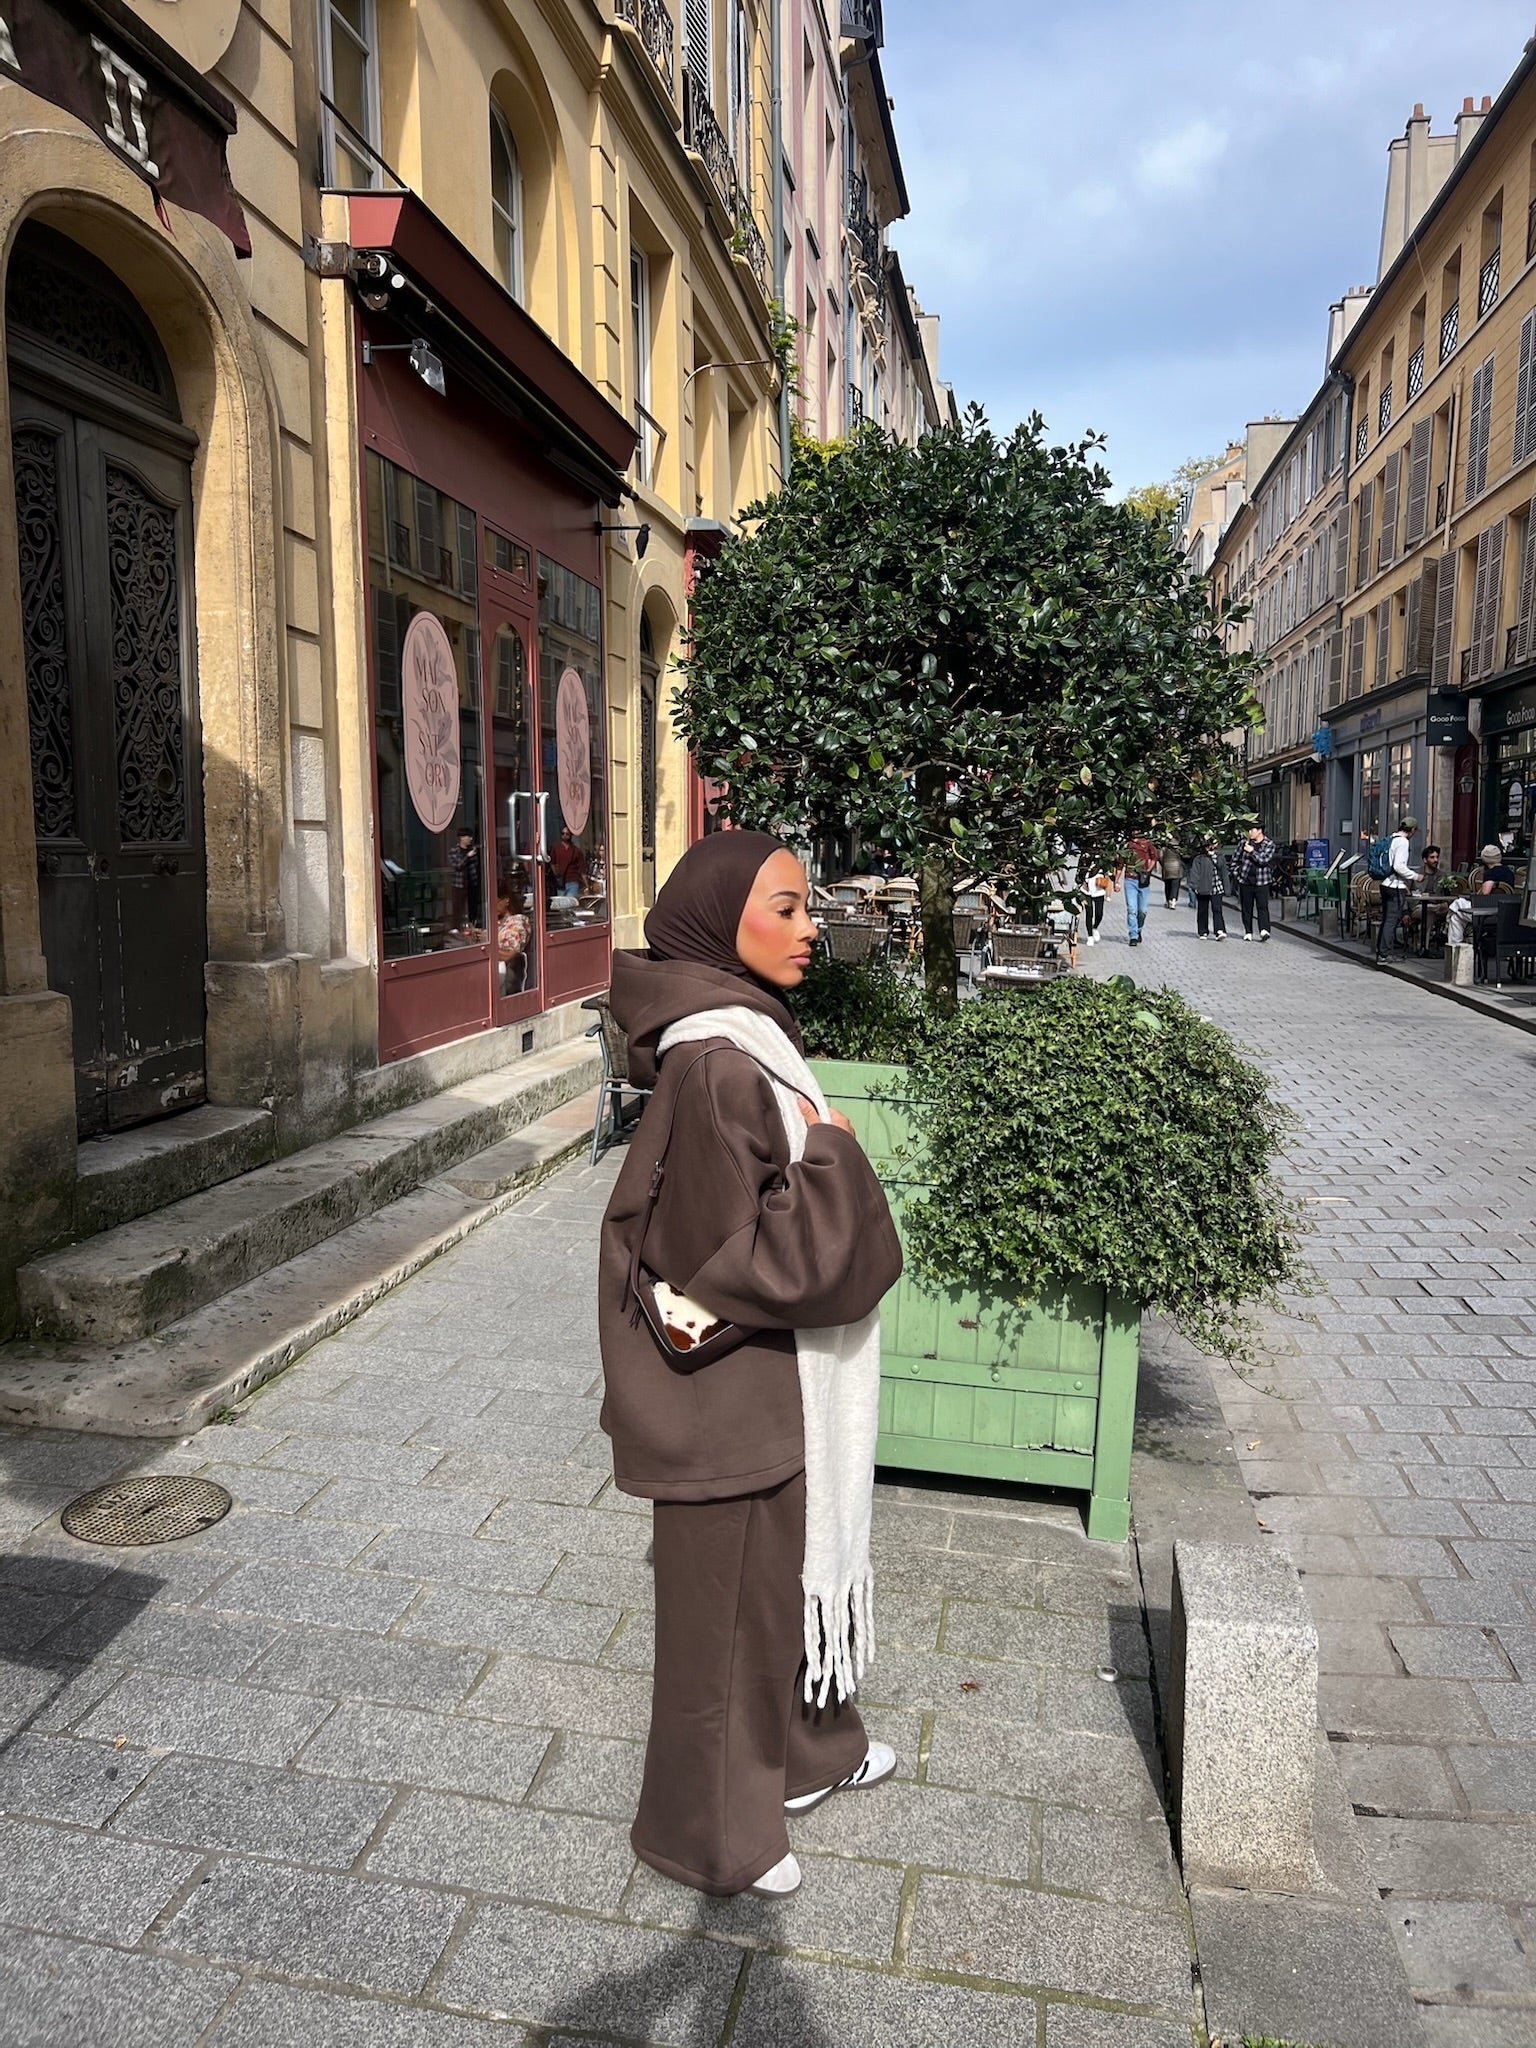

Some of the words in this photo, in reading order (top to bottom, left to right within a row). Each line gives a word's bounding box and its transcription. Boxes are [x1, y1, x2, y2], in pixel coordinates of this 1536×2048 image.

[421, 686, 447, 713] SON
[418, 730, 440, 758] SAT
[425, 762, 450, 787] ORY
